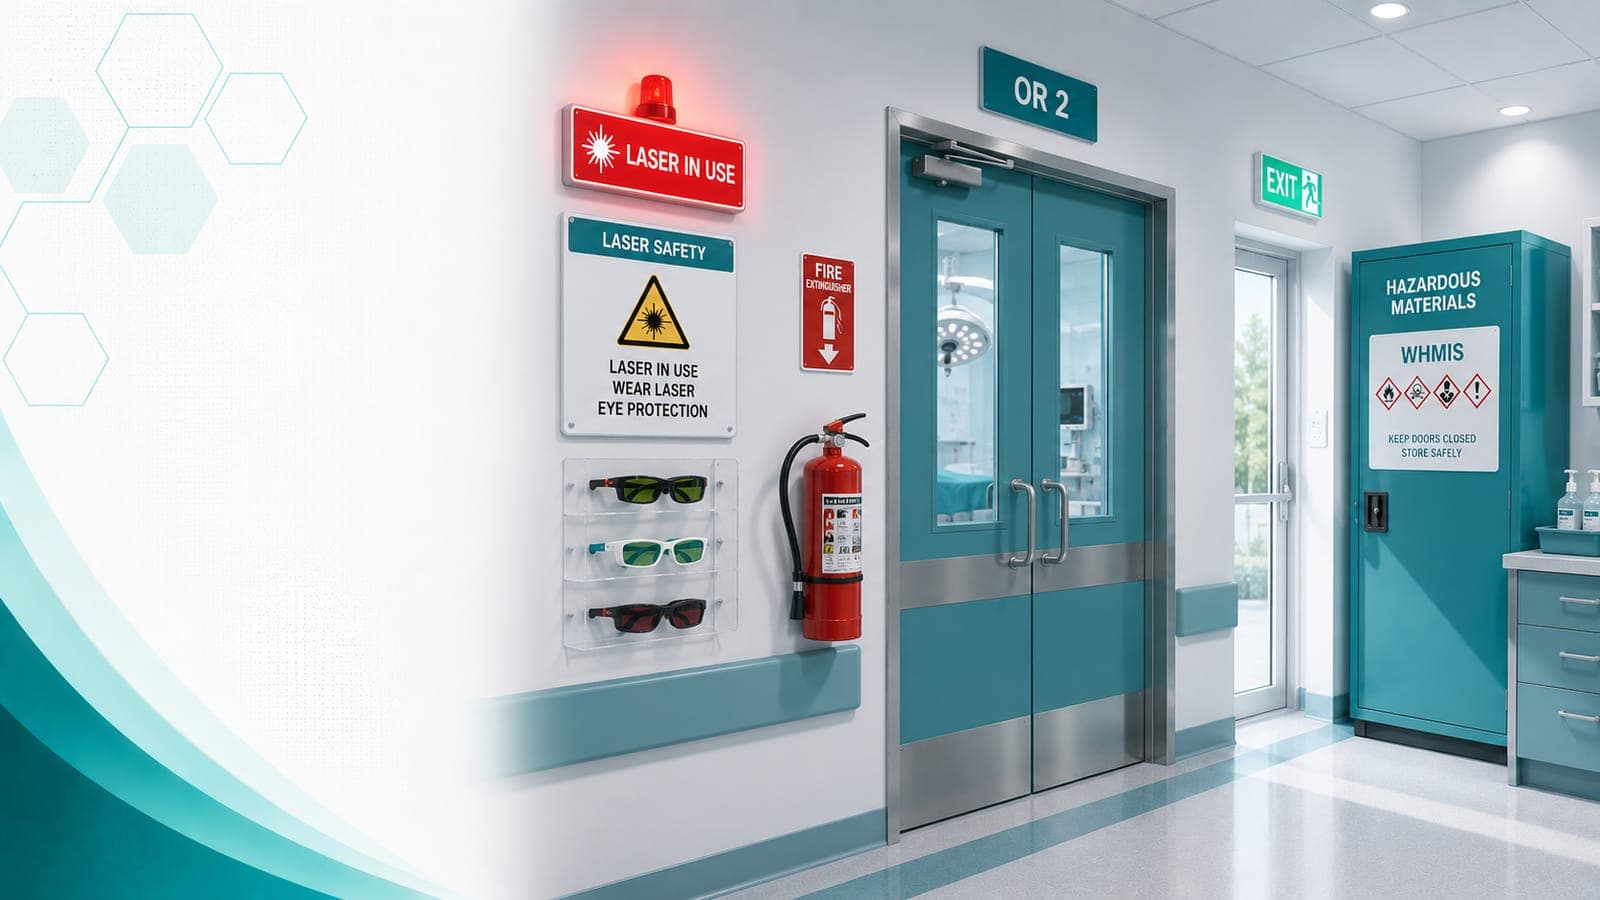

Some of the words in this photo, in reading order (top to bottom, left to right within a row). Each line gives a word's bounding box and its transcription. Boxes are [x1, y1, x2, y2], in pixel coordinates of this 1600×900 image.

[1014, 75, 1048, 113] OR
[1055, 89, 1069, 120] 2
[626, 143, 680, 174] LASER
[684, 155, 701, 178] IN
[705, 159, 736, 185] USE
[1266, 166, 1298, 200] EXIT
[602, 231, 650, 254] LASER
[653, 239, 706, 261] SAFETY
[815, 262, 842, 281] FIRE
[1386, 270, 1481, 296] HAZARDOUS
[1391, 292, 1477, 316] MATERIALS
[1401, 342, 1464, 364] WHMIS
[609, 359, 652, 376] LASER
[656, 362, 670, 377] IN
[674, 363, 698, 378] USE
[612, 380, 651, 396] WEAR
[655, 382, 695, 398] LASER
[598, 400, 623, 416] EYE
[627, 402, 708, 418] PROTECTION
[1388, 433, 1410, 444] KEEP
[1411, 433, 1440, 444] DOORS
[1442, 433, 1477, 444] CLOSED
[1401, 447, 1429, 458] STORE
[1430, 447, 1463, 458] SAFELY
